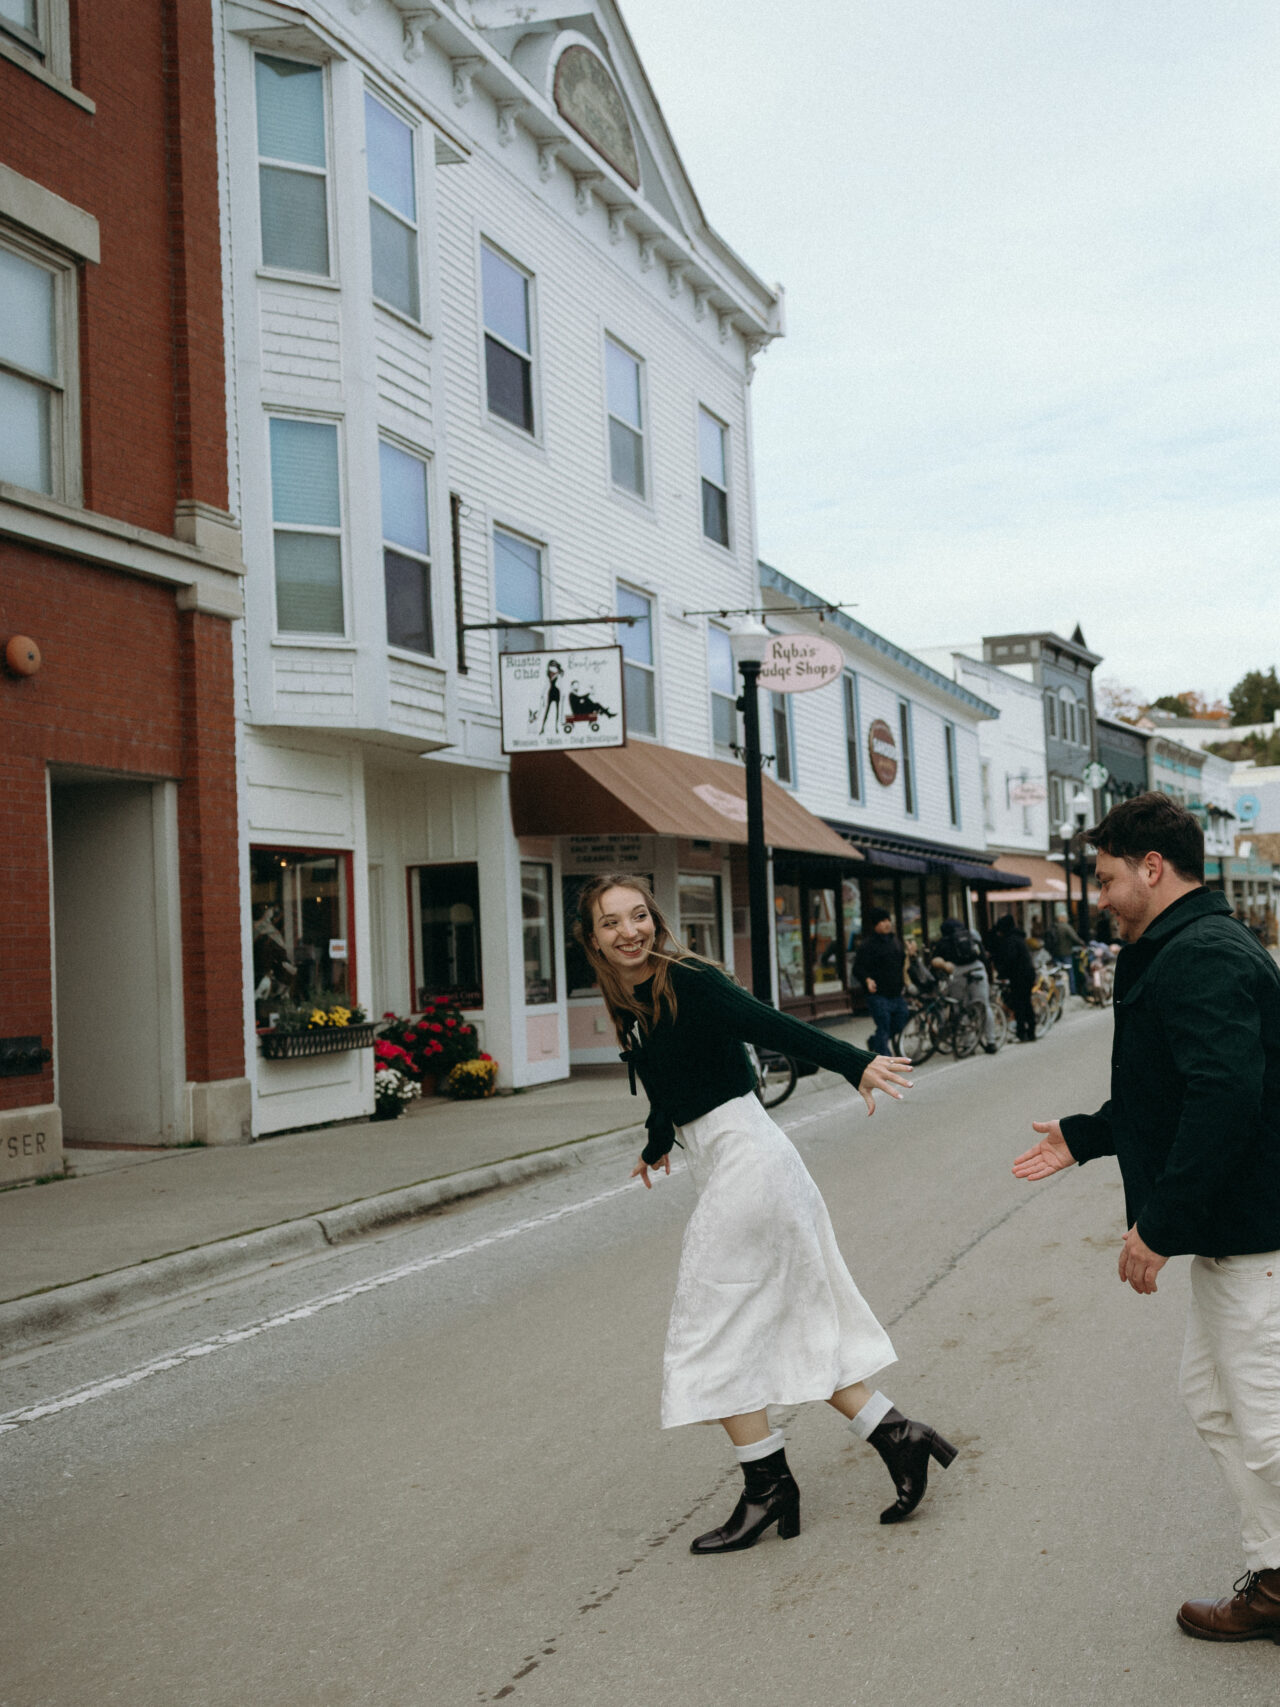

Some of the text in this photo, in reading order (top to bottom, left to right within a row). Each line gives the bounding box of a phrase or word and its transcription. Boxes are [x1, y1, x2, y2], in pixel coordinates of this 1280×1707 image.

[772, 641, 816, 663] Ryba's
[505, 656, 541, 668] Rustic
[513, 668, 540, 680] Chic
[796, 661, 836, 679] Shops
